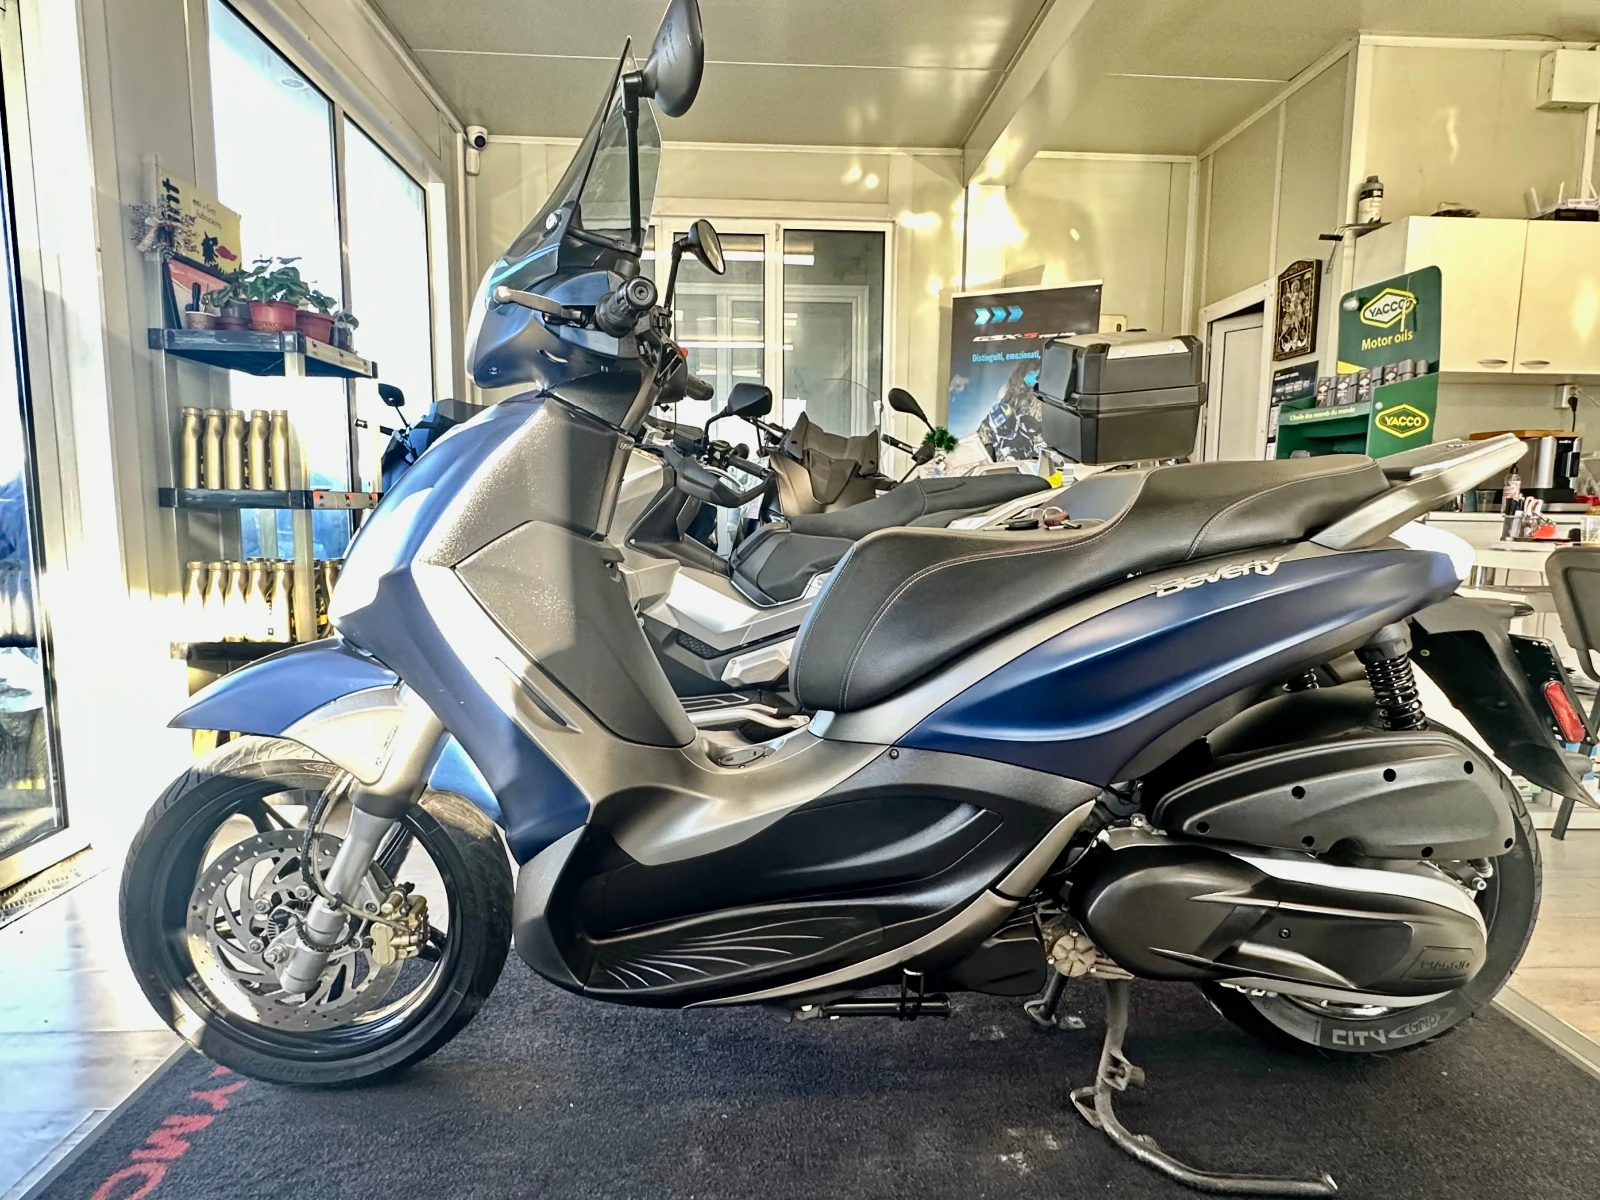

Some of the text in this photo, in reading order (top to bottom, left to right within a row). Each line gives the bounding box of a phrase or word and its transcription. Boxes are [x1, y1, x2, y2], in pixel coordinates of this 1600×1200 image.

[1369, 298, 1412, 318] YACCO
[1361, 329, 1414, 351] Motor oils
[1384, 415, 1422, 427] YACCO
[1150, 553, 1287, 598] Beverly
[1420, 959, 1470, 971] PIAGGIO
[1332, 1028, 1387, 1046] CITY
